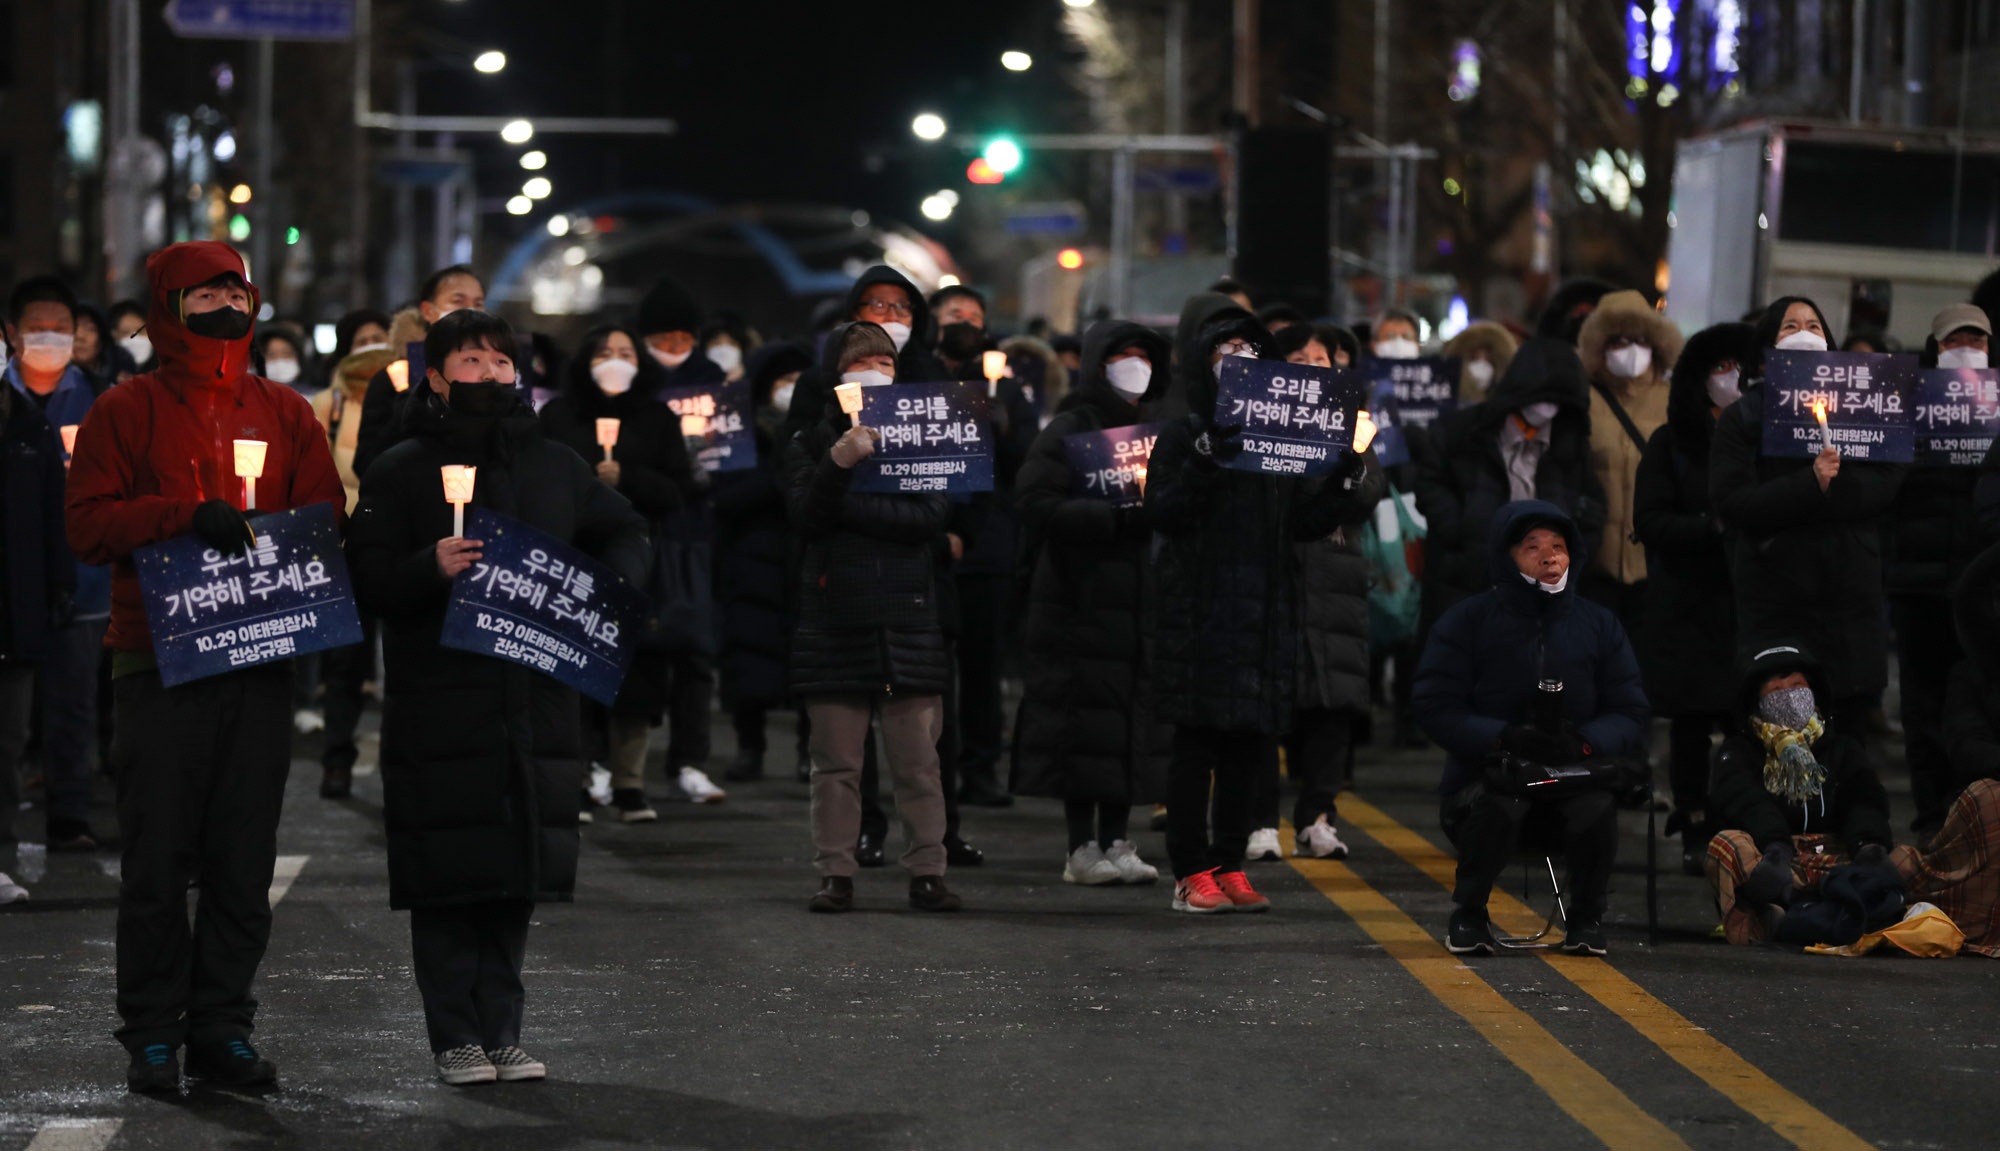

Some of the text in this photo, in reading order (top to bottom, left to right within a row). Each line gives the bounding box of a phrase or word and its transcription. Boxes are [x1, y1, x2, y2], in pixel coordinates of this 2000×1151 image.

[1812, 365, 1872, 389] 우리를
[1267, 376, 1322, 404] 우리를
[1779, 389, 1903, 415] 기억해 주세요
[1945, 381, 2000, 402] 우리를
[895, 397, 950, 421] 우리를
[1232, 399, 1290, 427] 기억해
[1293, 406, 1345, 431] 주세요
[1916, 404, 2000, 427] 기억해 주
[925, 422, 980, 447] 주세요
[1793, 427, 1884, 443] 10.29 이태원참사
[1930, 438, 1958, 451] 10.29
[1113, 435, 1158, 463] 우리
[1243, 439, 1327, 461] 10.29 이태원참사
[1844, 445, 1870, 458] 처벌!
[880, 461, 966, 476] 10.29 이태원참사
[1261, 457, 1306, 473] 진상규명!
[899, 477, 948, 491] 진상규명!
[522, 549, 595, 601] 우리를
[165, 561, 331, 618] 기억해 주세요
[471, 563, 619, 648] 기억해 주세요
[195, 611, 318, 653] 10.29 이태원참사
[476, 613, 588, 669] 10.29 이태원참사
[228, 636, 296, 666] 진상규명!
[494, 637, 558, 672] 진상규명!
